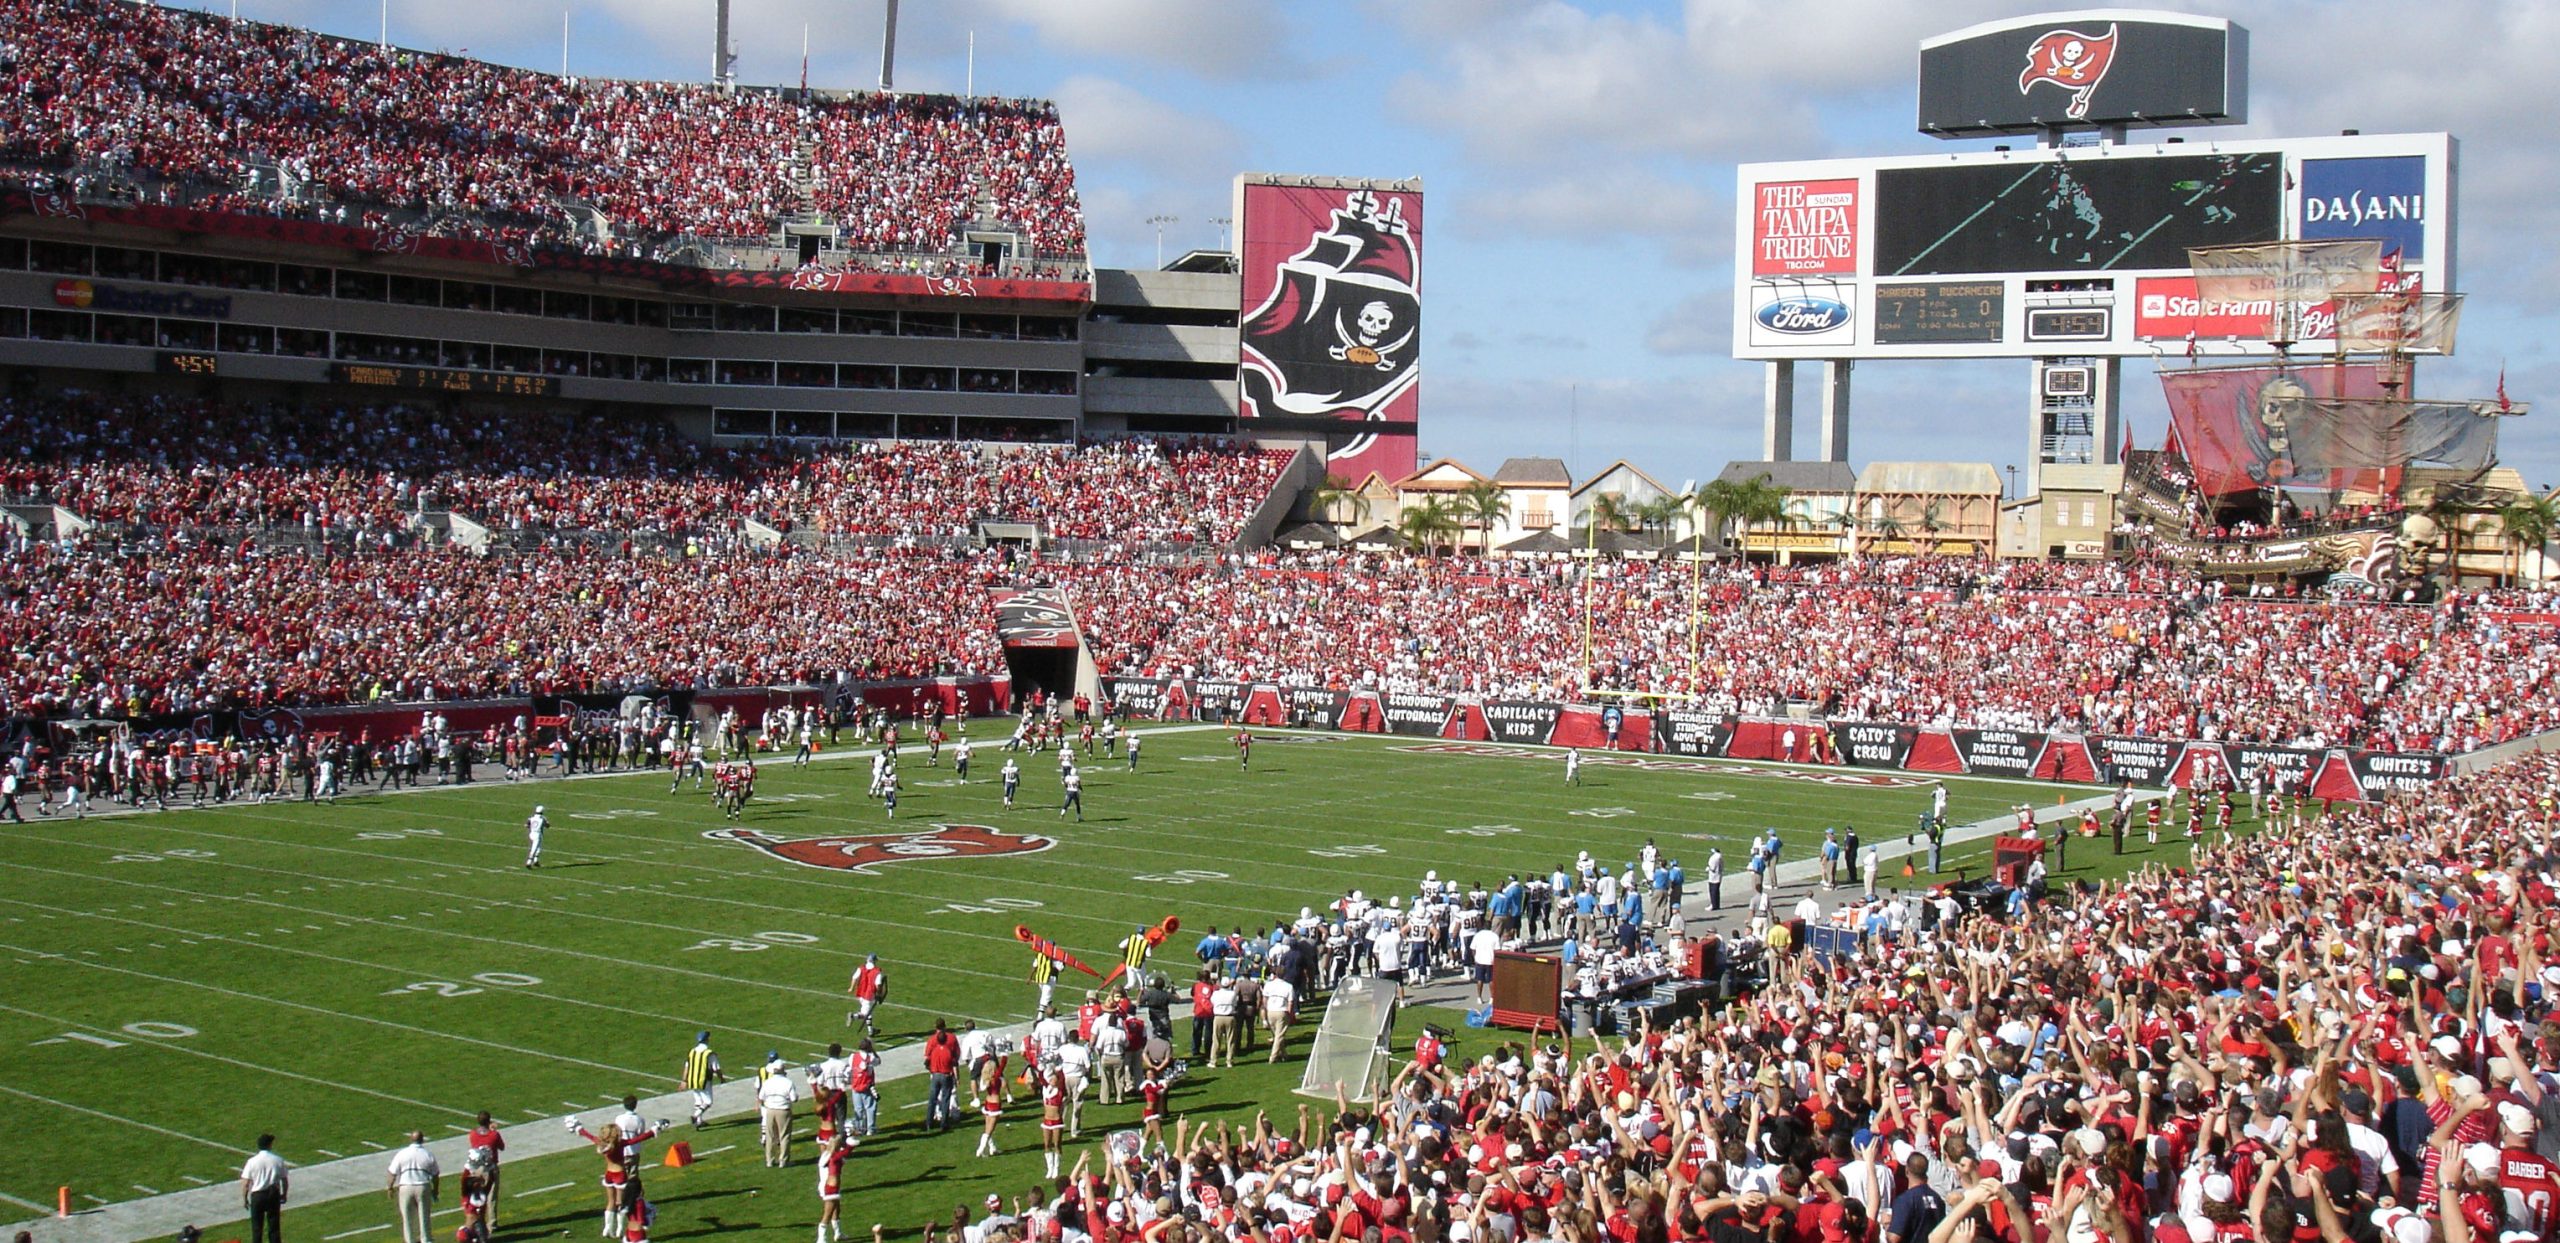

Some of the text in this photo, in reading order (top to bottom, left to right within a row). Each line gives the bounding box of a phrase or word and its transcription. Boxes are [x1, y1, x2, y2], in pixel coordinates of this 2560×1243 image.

[1762, 186, 1805, 208] THE
[1814, 196, 1850, 204] SUNDAY
[2307, 189, 2421, 227] DASANI
[1762, 207, 1851, 237] TAMPA
[1762, 235, 1851, 260] TRIBUNE
[1785, 261, 1825, 269] TBO.COM
[1772, 302, 1834, 329] Ford
[1893, 301, 1903, 317] 7
[1980, 300, 1990, 316] 0
[2051, 315, 2102, 333] 4:54
[173, 355, 216, 373] 4:54
[1487, 705, 1555, 721] CADILLAC'S
[1506, 723, 1535, 736] KIDS
[1849, 726, 1896, 743] CATO'S
[1981, 731, 2018, 743] GARCIA
[1680, 742, 1708, 754] BOAD
[1853, 744, 1891, 760] CREW
[1972, 742, 2026, 757] PASS IT ON
[1969, 755, 2029, 769] FOUNDATION
[2241, 751, 2307, 766] BRYANT'S
[2370, 756, 2431, 774] WHITE'S
[1463, 916, 1478, 930] 98
[1414, 925, 1428, 938] 97
[700, 931, 820, 952] 30
[406, 972, 543, 998] 20
[60, 1021, 200, 1049] 10
[2507, 1160, 2545, 1179] BARBER
